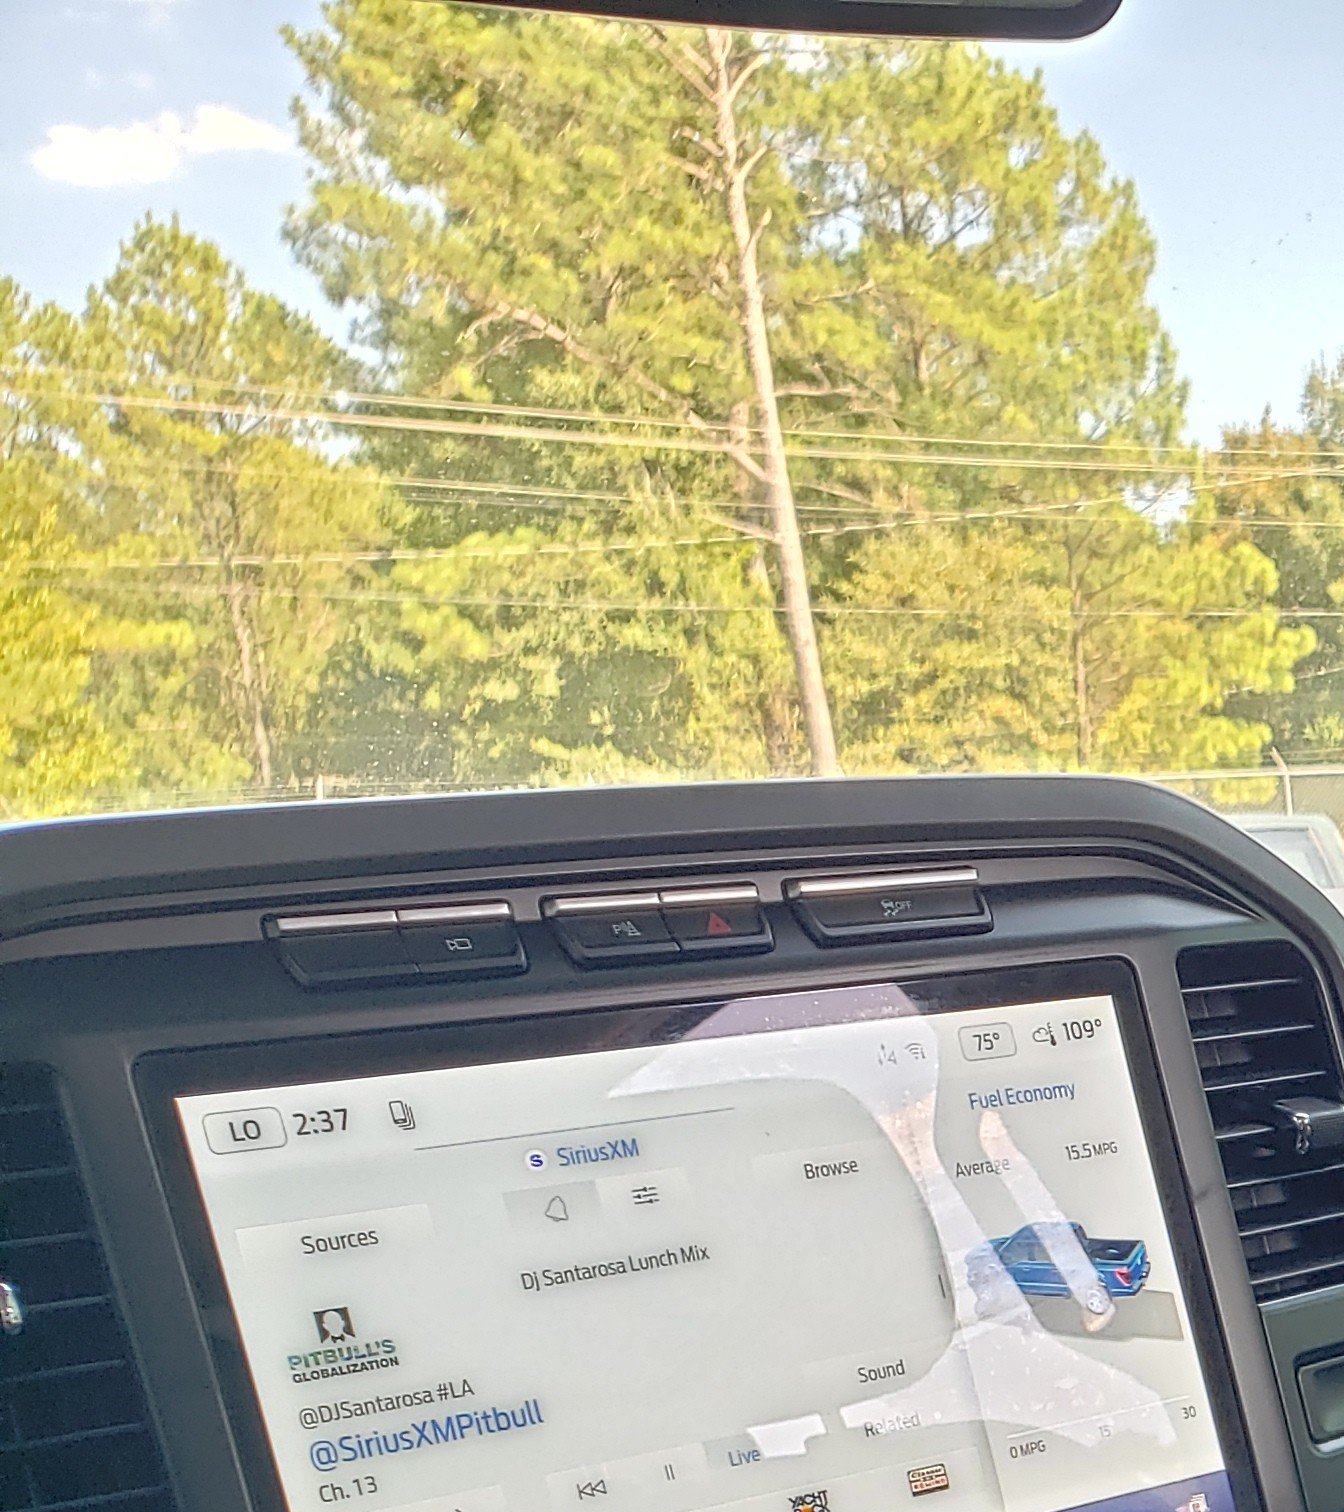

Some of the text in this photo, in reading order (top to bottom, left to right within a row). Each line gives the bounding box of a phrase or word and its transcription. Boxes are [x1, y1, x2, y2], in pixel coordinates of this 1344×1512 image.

[1061, 1020, 1102, 1042] 109°
[968, 1082, 1076, 1111] Fuel Economy
[228, 1108, 349, 1142] LO 2:37
[557, 1138, 640, 1167] SiriusXM
[955, 1155, 1011, 1178] Average
[804, 1157, 859, 1180] Browse
[300, 1229, 379, 1255] Sources
[521, 1244, 711, 1291] Dj Santarosa Lunch Mix
[287, 1339, 397, 1371] PITBULL'S
[292, 1356, 399, 1384] GLOBALIZATION
[858, 1360, 906, 1384] Sound
[299, 1378, 476, 1430] @DJSantarosa #LA
[1181, 1405, 1197, 1420] 30
[309, 1399, 545, 1472] @SiriusXMPitbull
[1020, 1439, 1047, 1457] MPG
[728, 1449, 761, 1467] Live
[319, 1475, 378, 1503] Ch. 13
